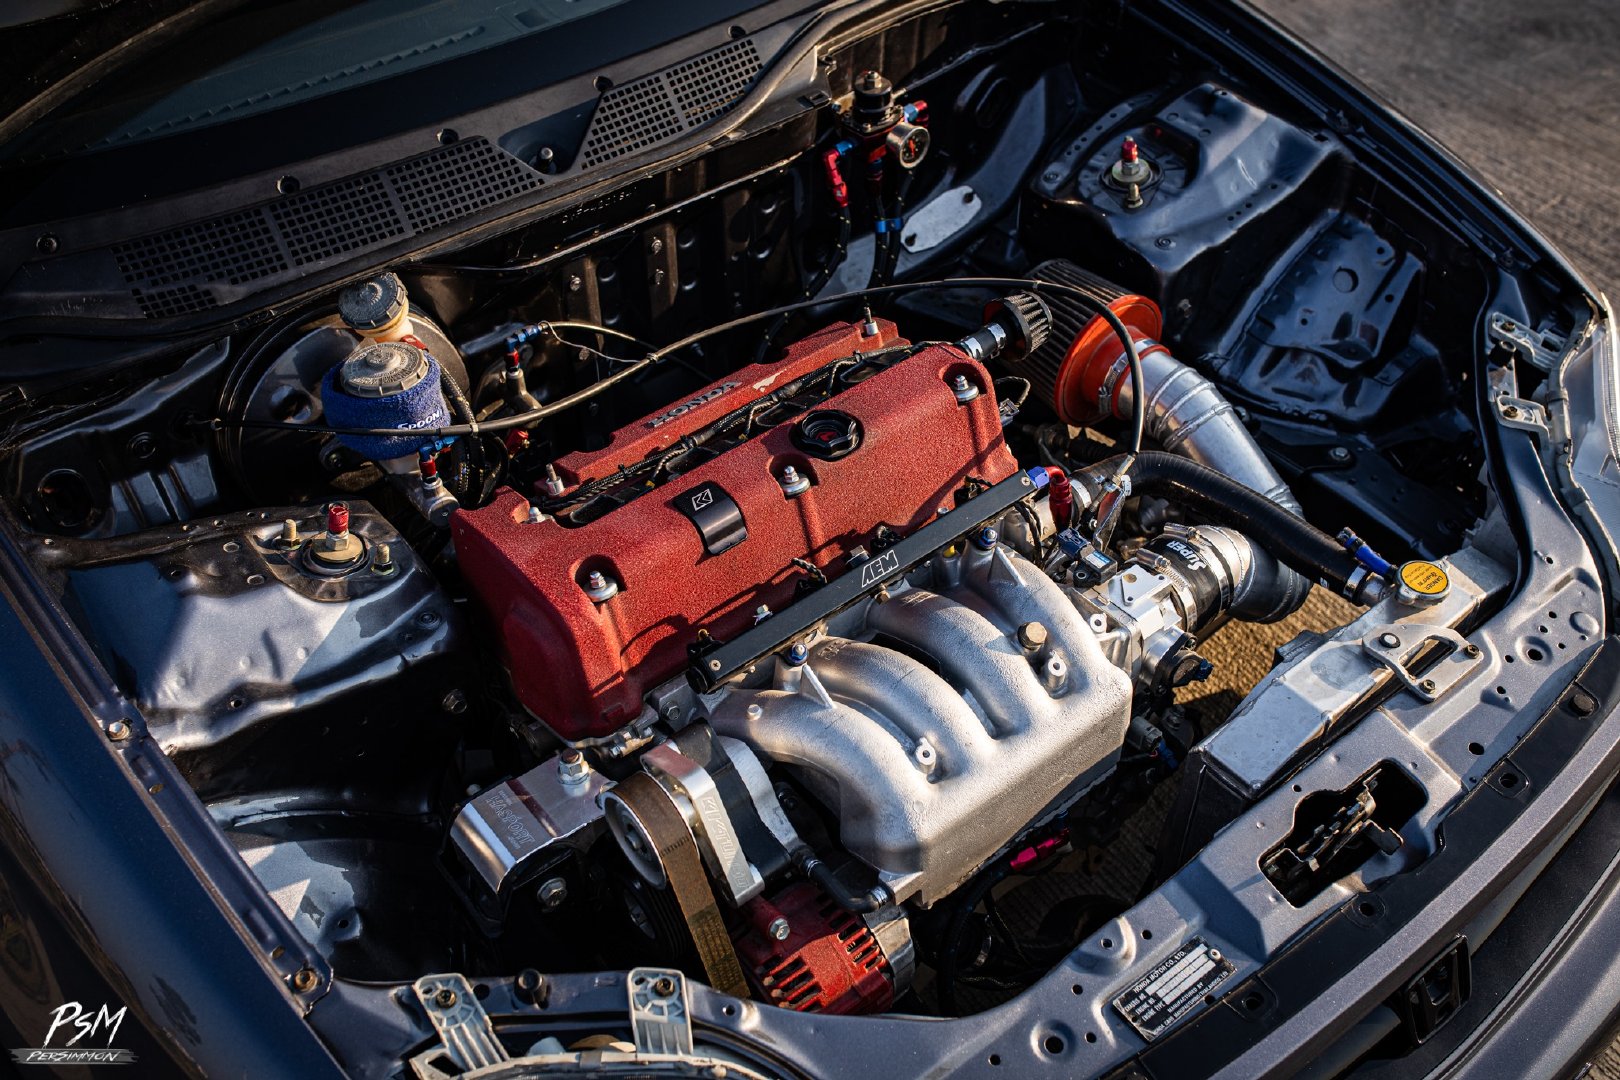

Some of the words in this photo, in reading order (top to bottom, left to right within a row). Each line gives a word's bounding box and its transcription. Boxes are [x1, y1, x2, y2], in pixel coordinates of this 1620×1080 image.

[649, 381, 742, 428] HONDA
[861, 549, 899, 588] AEM
[1166, 540, 1207, 571] SUPER
[485, 795, 536, 845] HASPORT
[1133, 977, 1151, 994] HONDA
[1149, 965, 1168, 981] MOTOR
